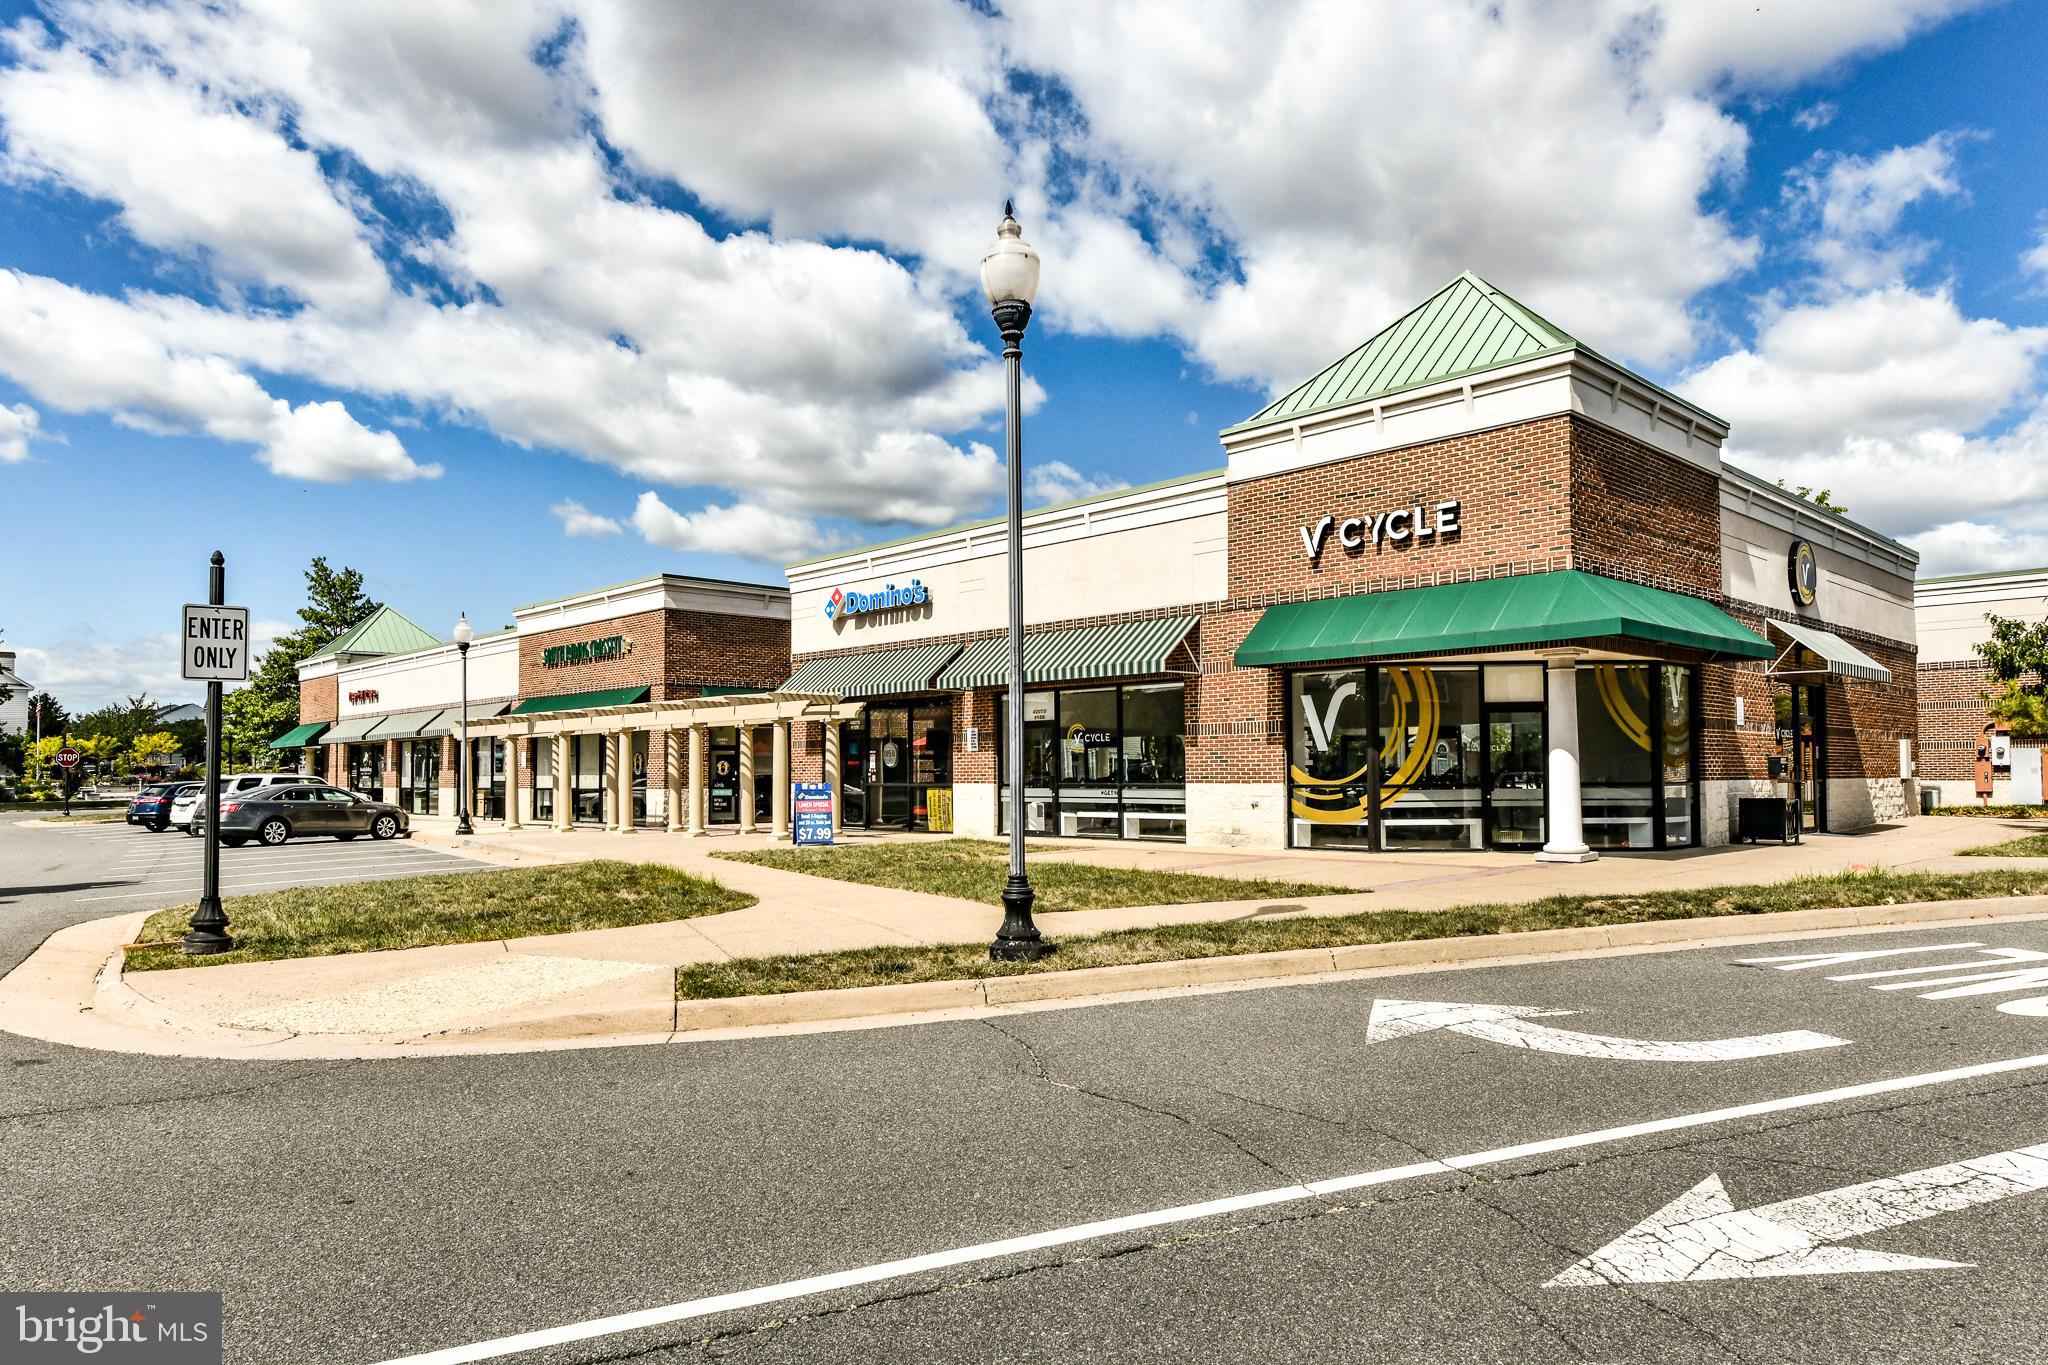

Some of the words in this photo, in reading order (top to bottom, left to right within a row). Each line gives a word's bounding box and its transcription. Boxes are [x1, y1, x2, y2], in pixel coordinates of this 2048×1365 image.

[1300, 516, 1332, 558] V
[1339, 501, 1458, 547] CYCLE
[845, 578, 926, 614] Domino's
[188, 617, 244, 640] ENTER
[194, 646, 237, 668] ONLY
[1300, 682, 1357, 751] V
[1084, 733, 1111, 743] CYCLE
[58, 753, 78, 762] STOP
[799, 827, 831, 841] $7.99
